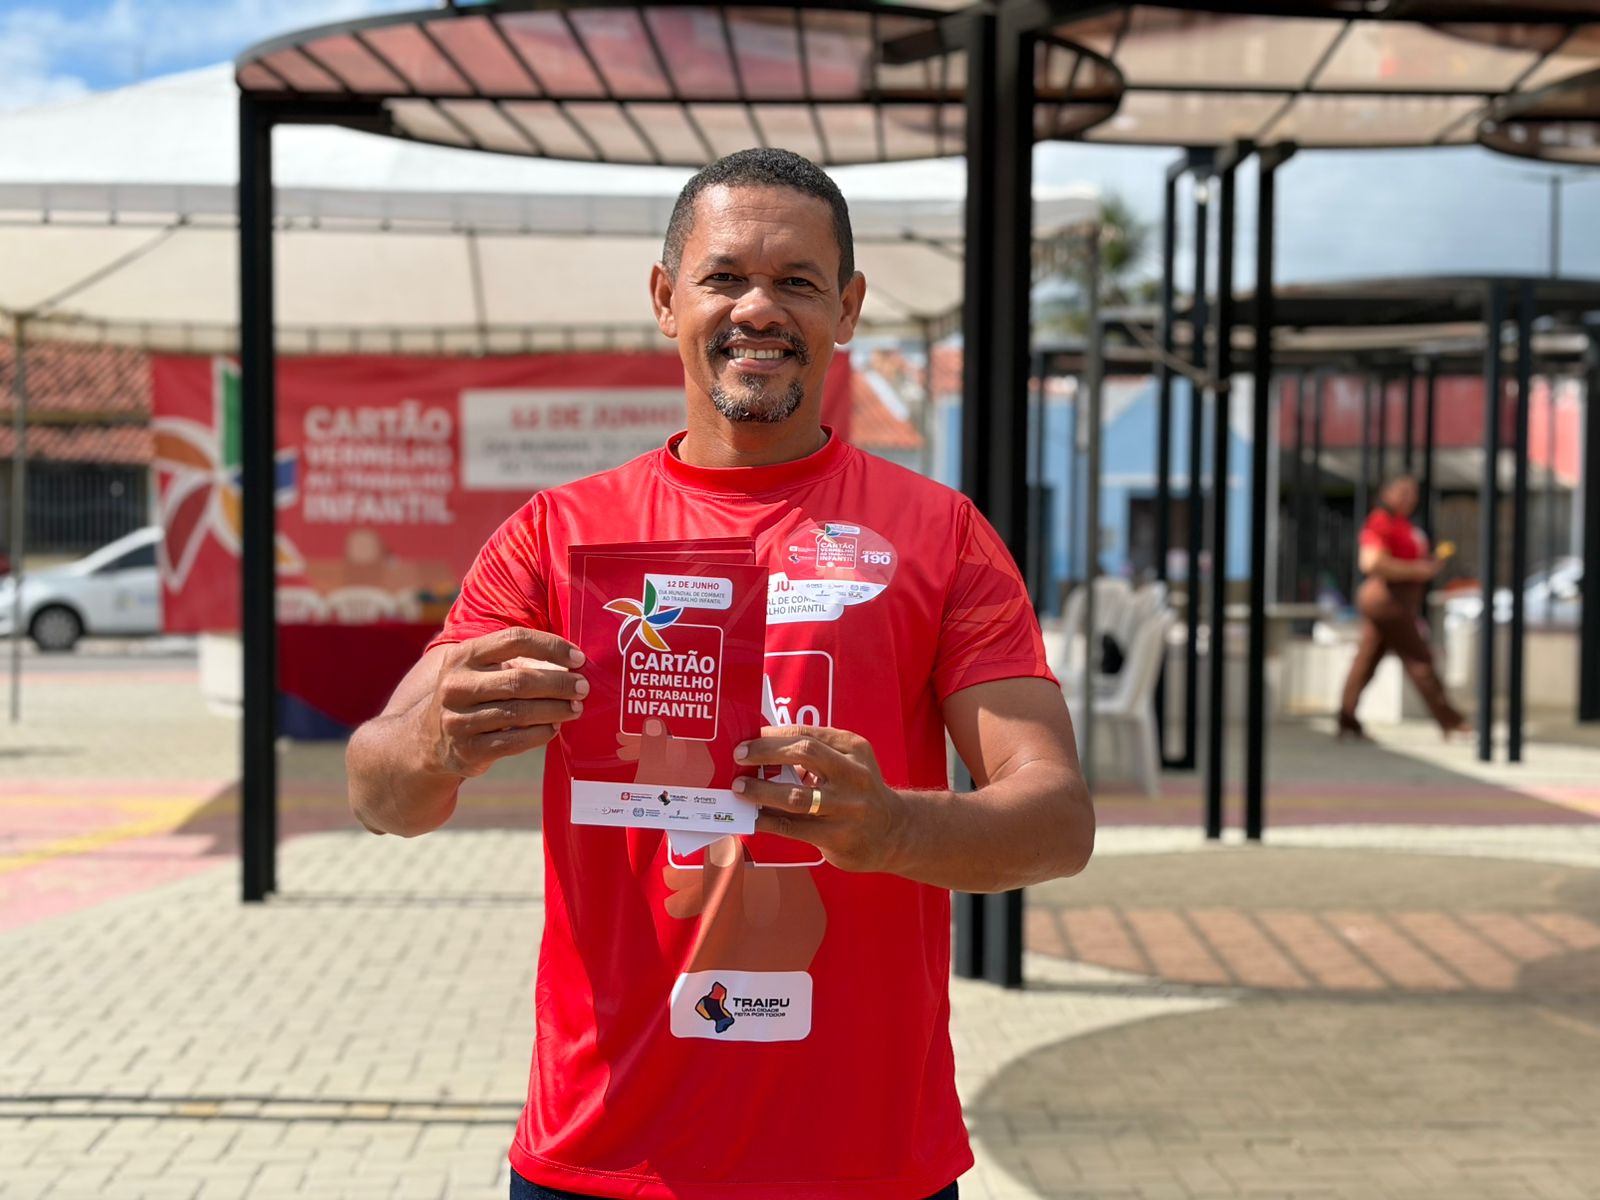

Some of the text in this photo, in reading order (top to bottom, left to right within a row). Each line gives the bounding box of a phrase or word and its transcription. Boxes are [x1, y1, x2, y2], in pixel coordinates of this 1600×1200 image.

[303, 399, 452, 440] CARTÃO
[304, 444, 452, 466] VERMELHO
[303, 495, 455, 523] INFANTIL
[860, 554, 891, 564] 190
[691, 582, 720, 590] JUNHO
[774, 580, 794, 592] JU
[766, 604, 826, 615] LHO INFANTIL
[630, 650, 715, 674] CARTÃO
[630, 672, 714, 689] VERMELHO
[628, 688, 713, 702] AO TRABALHO
[628, 700, 713, 719] INFANTIL
[732, 998, 790, 1008] TRAIPU
